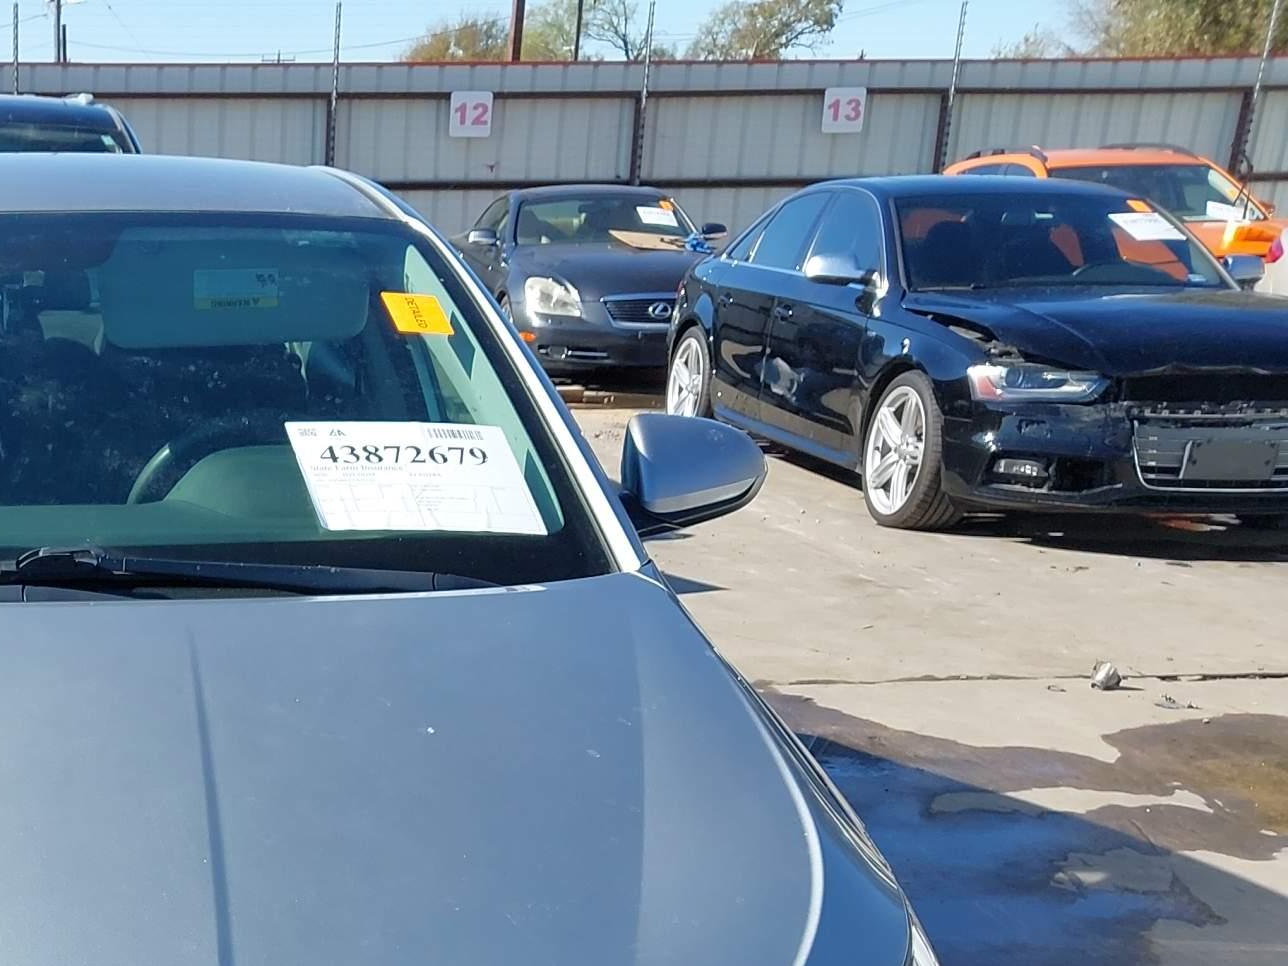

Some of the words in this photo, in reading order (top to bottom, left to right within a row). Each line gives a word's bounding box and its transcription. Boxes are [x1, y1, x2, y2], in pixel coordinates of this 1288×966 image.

[454, 102, 489, 126] 12
[827, 97, 862, 122] 13
[319, 444, 489, 466] 43872679
